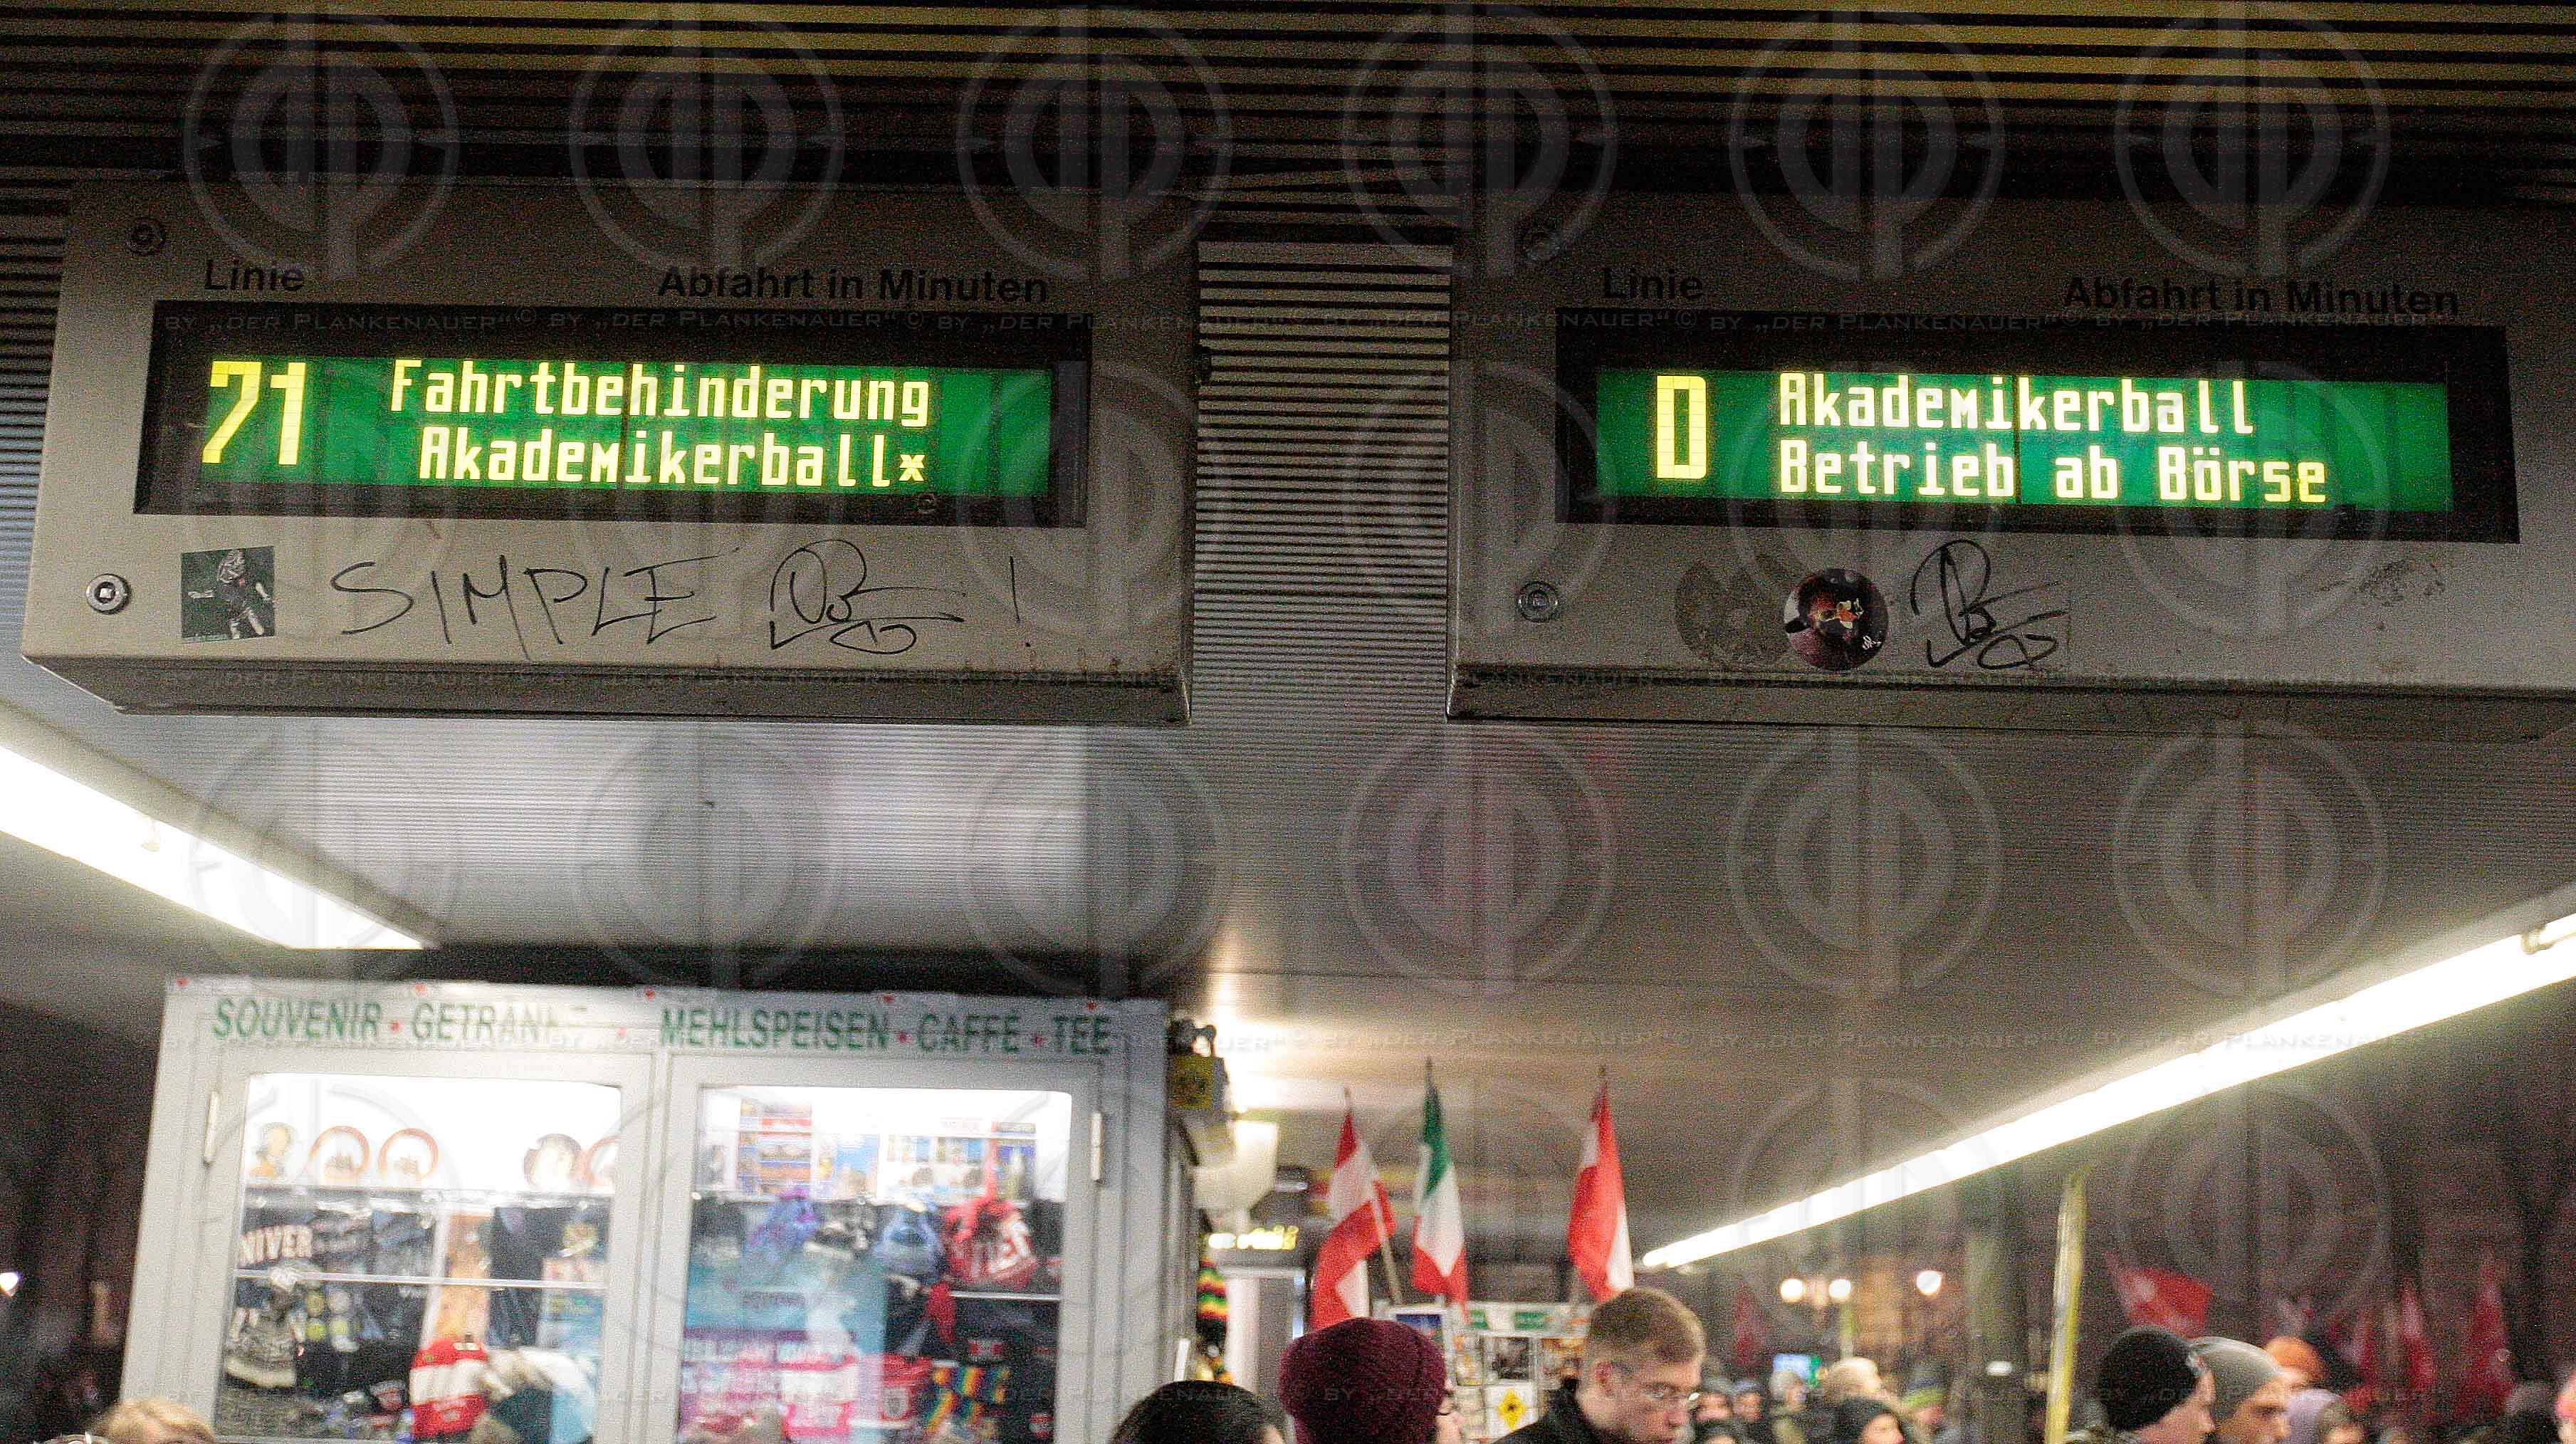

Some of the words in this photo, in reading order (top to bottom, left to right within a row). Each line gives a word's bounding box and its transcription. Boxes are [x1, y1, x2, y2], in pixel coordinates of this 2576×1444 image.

[204, 259, 305, 292] Linie
[658, 266, 813, 300] Abfahrt
[828, 269, 864, 299] in
[879, 268, 1049, 303] Minuten
[1602, 266, 1704, 300] Linie
[2064, 276, 2223, 310] Abfahrt
[2235, 278, 2270, 312] in
[2288, 280, 2459, 315] Minuten
[201, 360, 307, 465] 71
[390, 359, 930, 427] Fahrtbehinderung
[1779, 371, 2253, 434] Akademikerball
[1656, 375, 1707, 479] D
[1779, 439, 2015, 497] Betrieb
[2054, 446, 2119, 500] ab
[2158, 446, 2327, 503] Börse
[330, 554, 718, 661] SIMPLE
[213, 998, 382, 1041] SOUVENIR
[659, 1007, 888, 1050] MEHLSPEISEN
[1052, 1013, 1111, 1056] TEE
